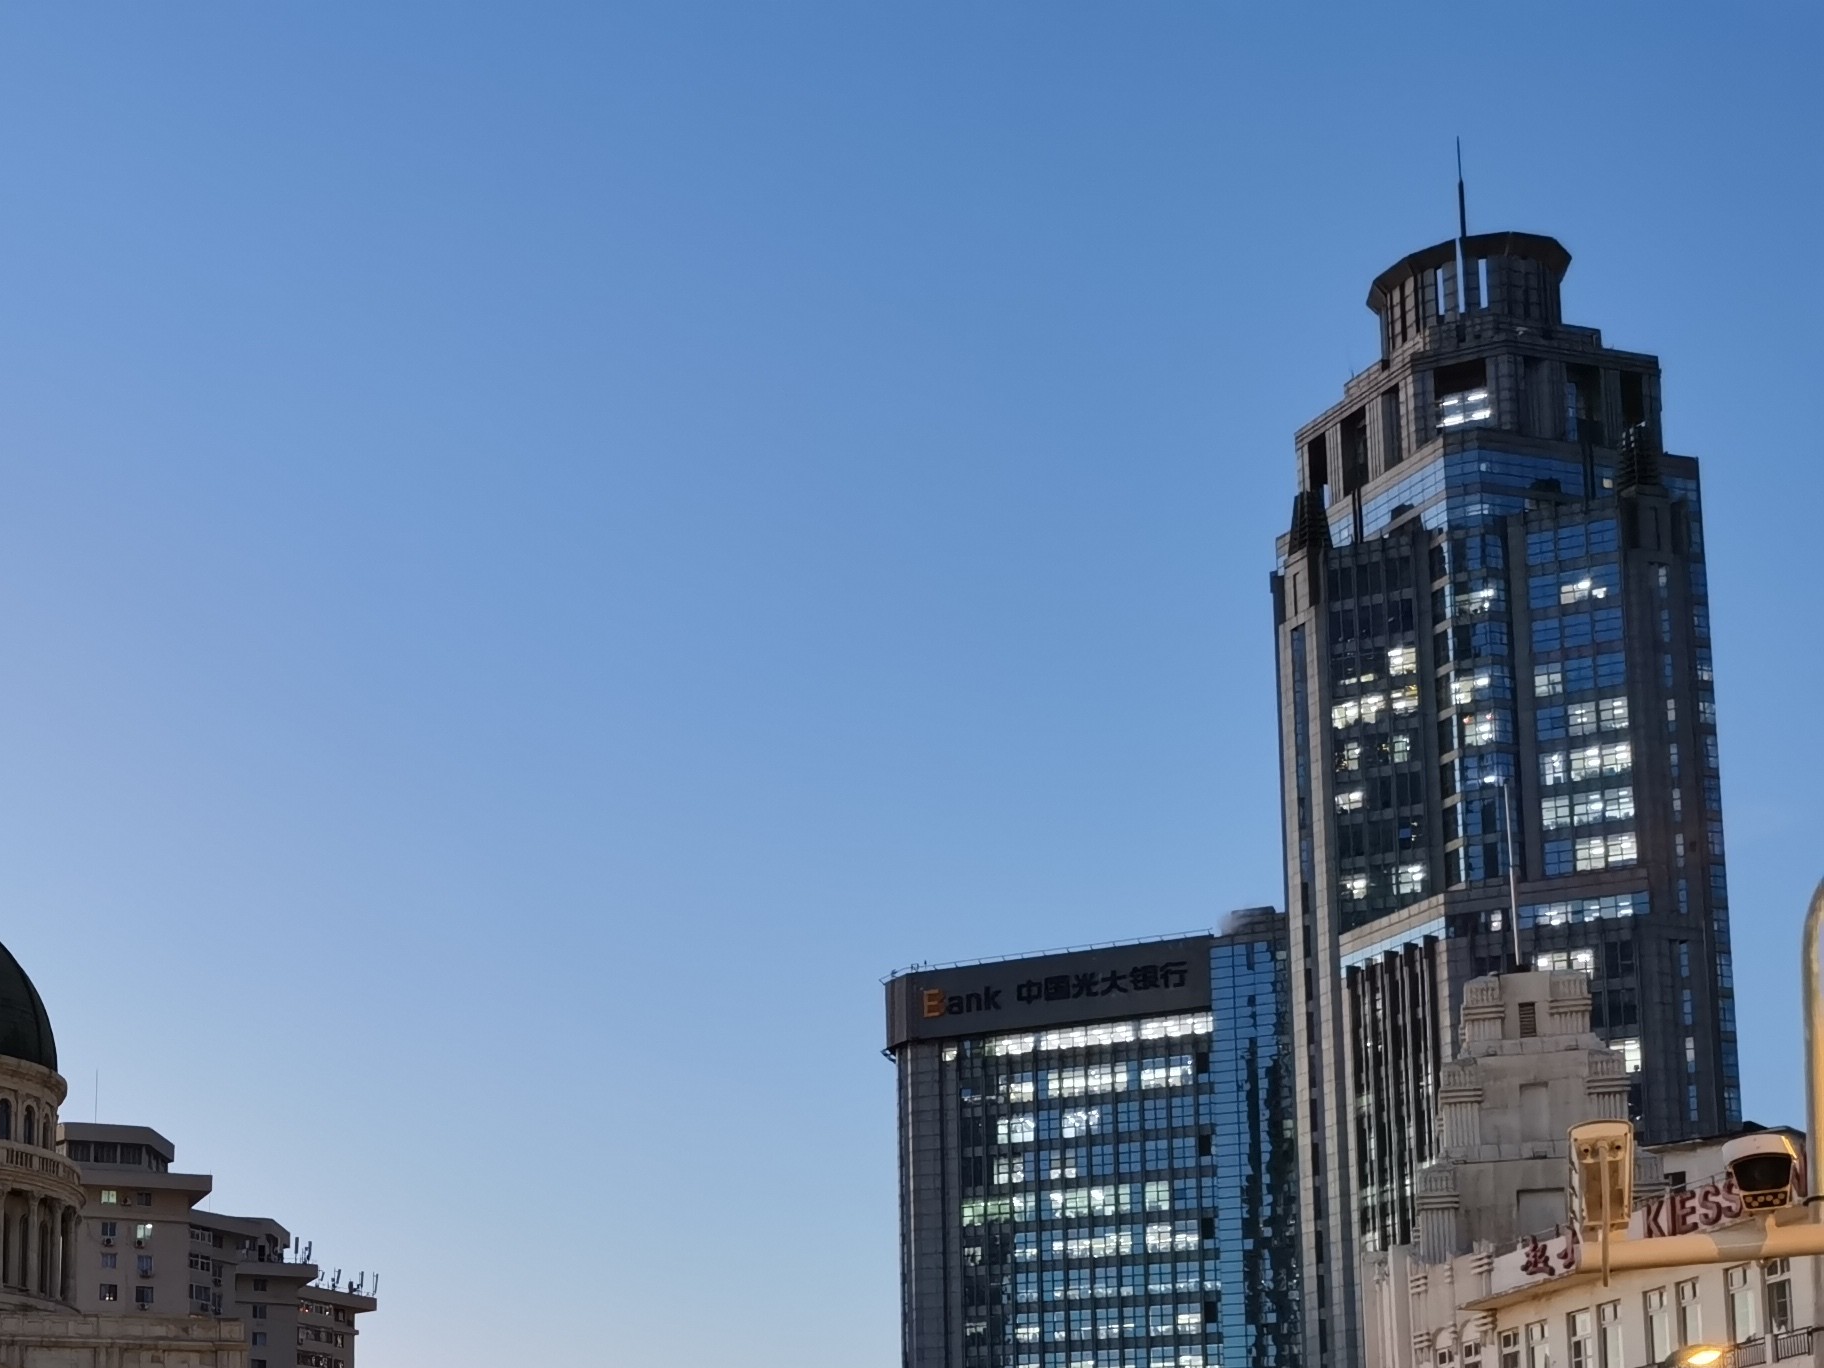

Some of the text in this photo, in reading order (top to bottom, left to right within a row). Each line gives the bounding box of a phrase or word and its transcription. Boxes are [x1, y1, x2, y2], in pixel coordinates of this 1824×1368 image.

[1016, 960, 1188, 1005] 中国光大银行
